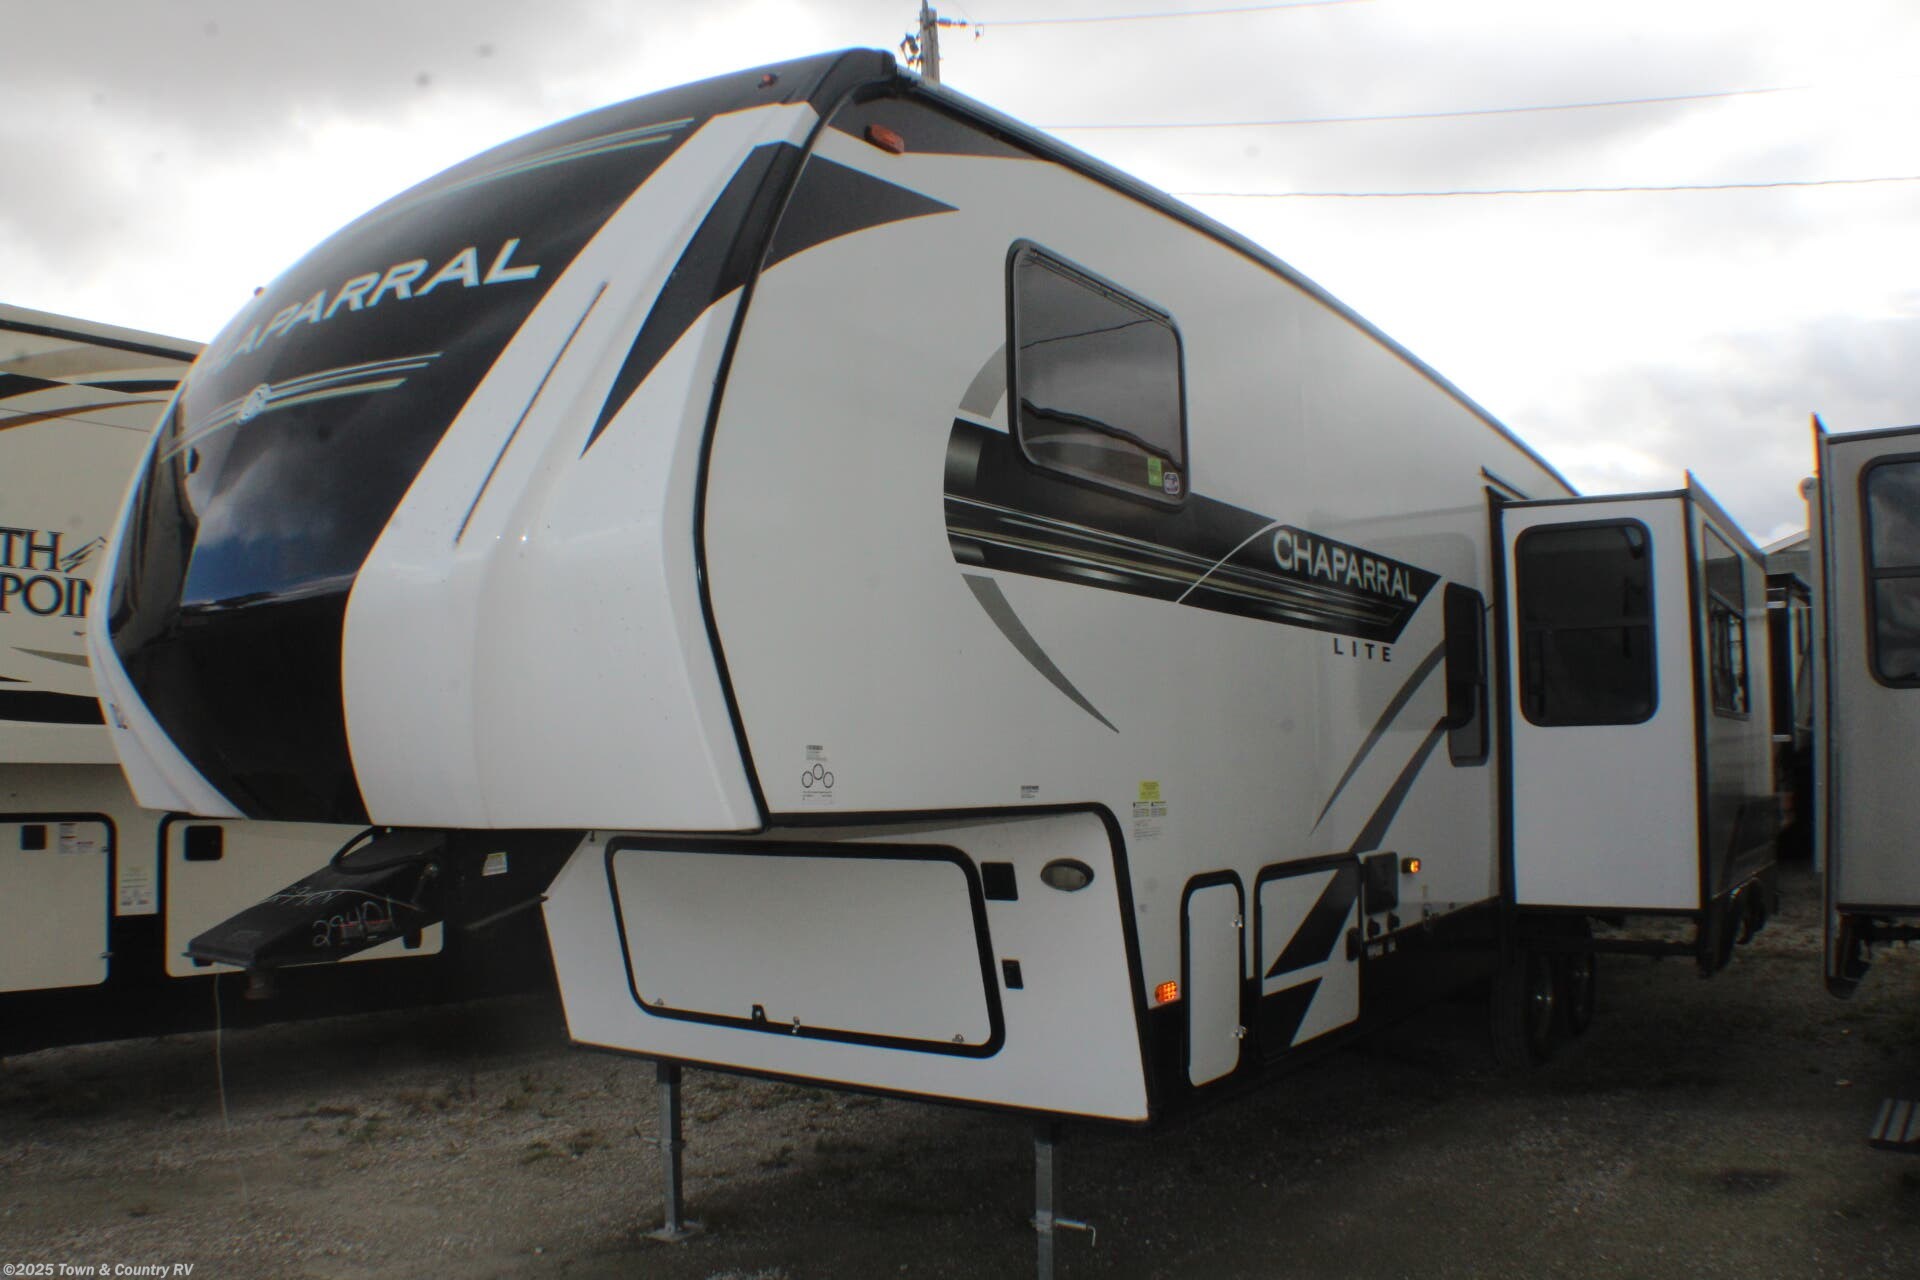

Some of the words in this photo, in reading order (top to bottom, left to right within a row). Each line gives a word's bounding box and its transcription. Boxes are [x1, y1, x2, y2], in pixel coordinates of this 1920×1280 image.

[203, 238, 541, 376] APARRAL
[1273, 529, 1418, 604] CHAPARRAL
[1333, 637, 1392, 662] LITE
